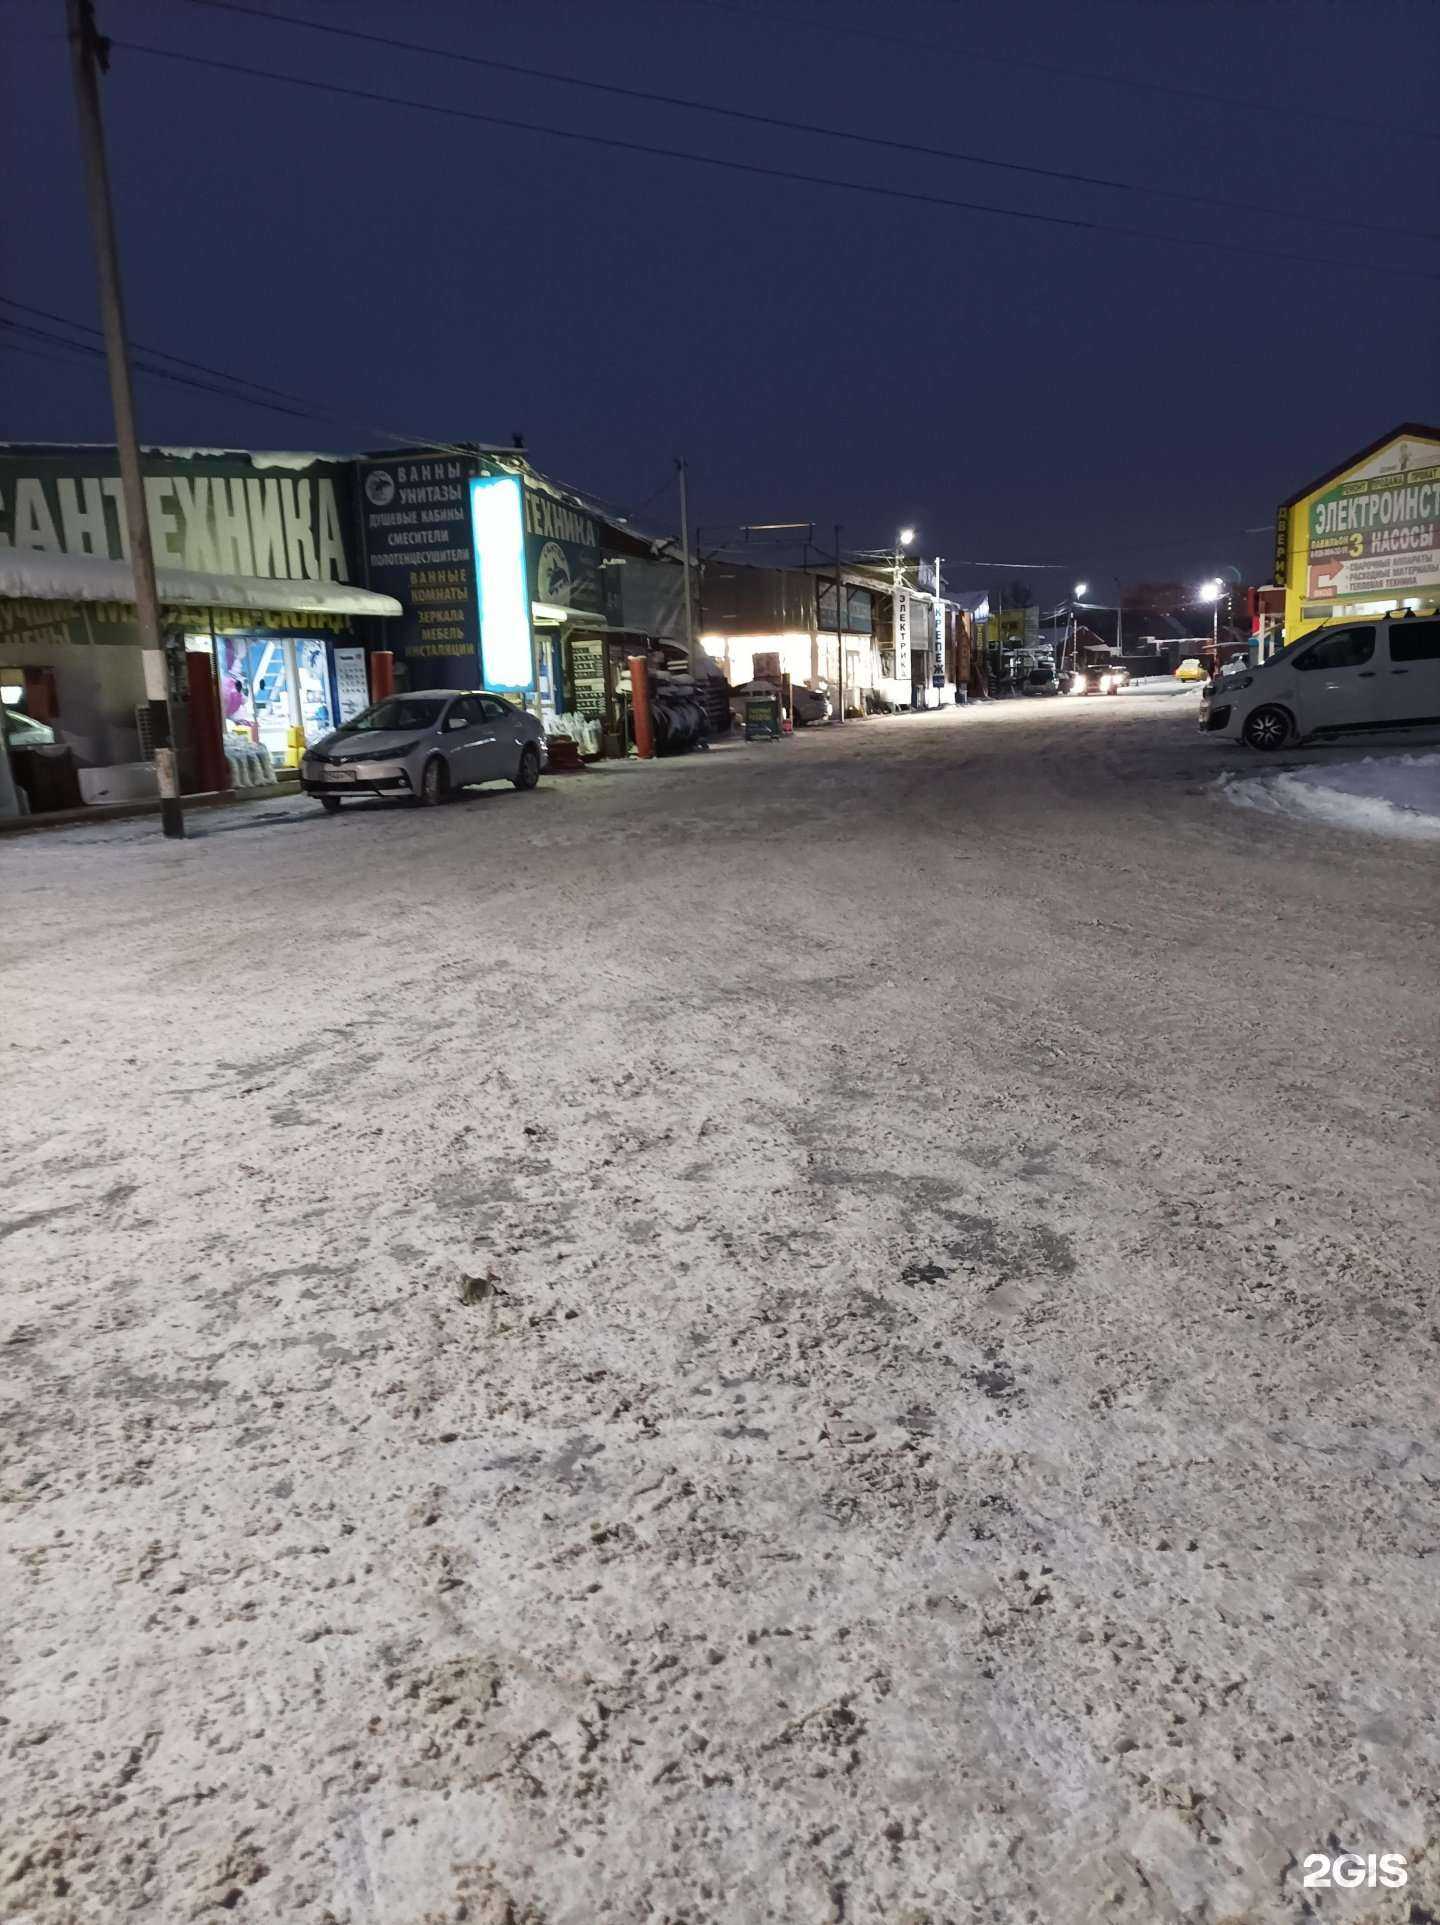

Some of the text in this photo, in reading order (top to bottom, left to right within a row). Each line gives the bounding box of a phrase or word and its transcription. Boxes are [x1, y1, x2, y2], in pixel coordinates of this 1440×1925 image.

[398, 462, 461, 483] ВАННЫ
[399, 484, 462, 505] УНИТАЗЫ
[369, 507, 464, 528] ДУШЕВЫЕ КАБИНЫ
[387, 529, 449, 546] СМЕСИТЕЛИ
[1311, 535, 1349, 550] ПАВИЛЬОН
[1350, 533, 1364, 558] 3
[1371, 524, 1434, 554] НАСОСЫ
[370, 548, 470, 567] ПОЛОТЕНЦЕСУШИТЕЛИ
[410, 569, 467, 585] ВАННЫЕ
[411, 587, 468, 602] КОМНАТЫ
[417, 610, 465, 624] ЗЕРКАЛА
[422, 628, 465, 641] МЕБЕЛЬ
[899, 594, 907, 678] ЭЛЕКТРИКА
[934, 608, 944, 674] КРЕПЕЖ
